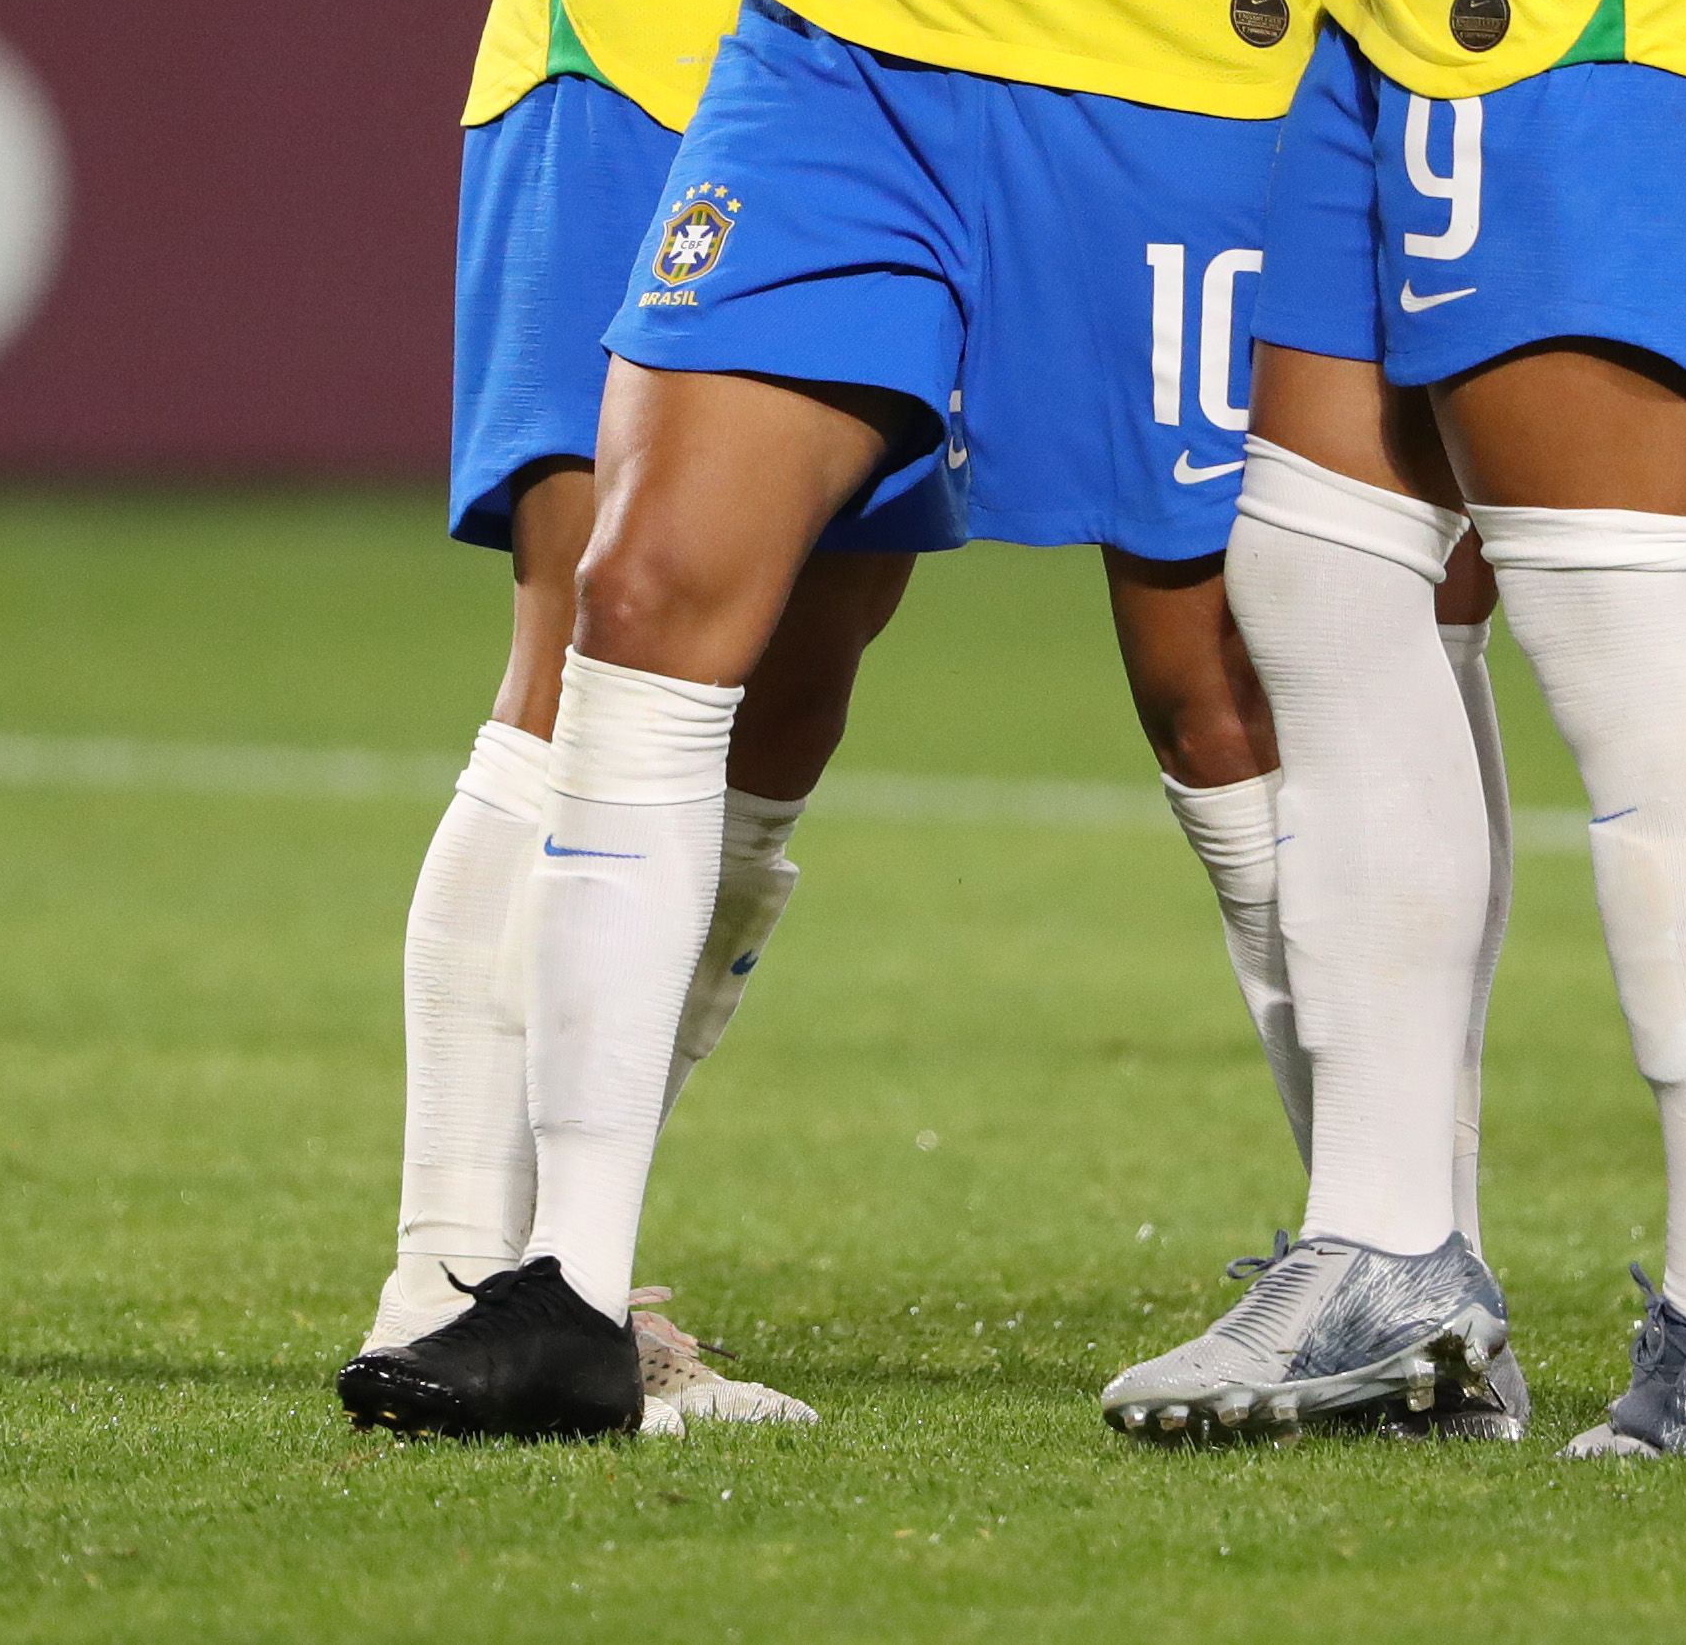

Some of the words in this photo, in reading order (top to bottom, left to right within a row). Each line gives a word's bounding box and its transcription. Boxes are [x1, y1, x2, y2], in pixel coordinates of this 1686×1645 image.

[1403, 93, 1484, 261] 9
[680, 239, 704, 250] CBF
[638, 289, 700, 308] BRASIL
